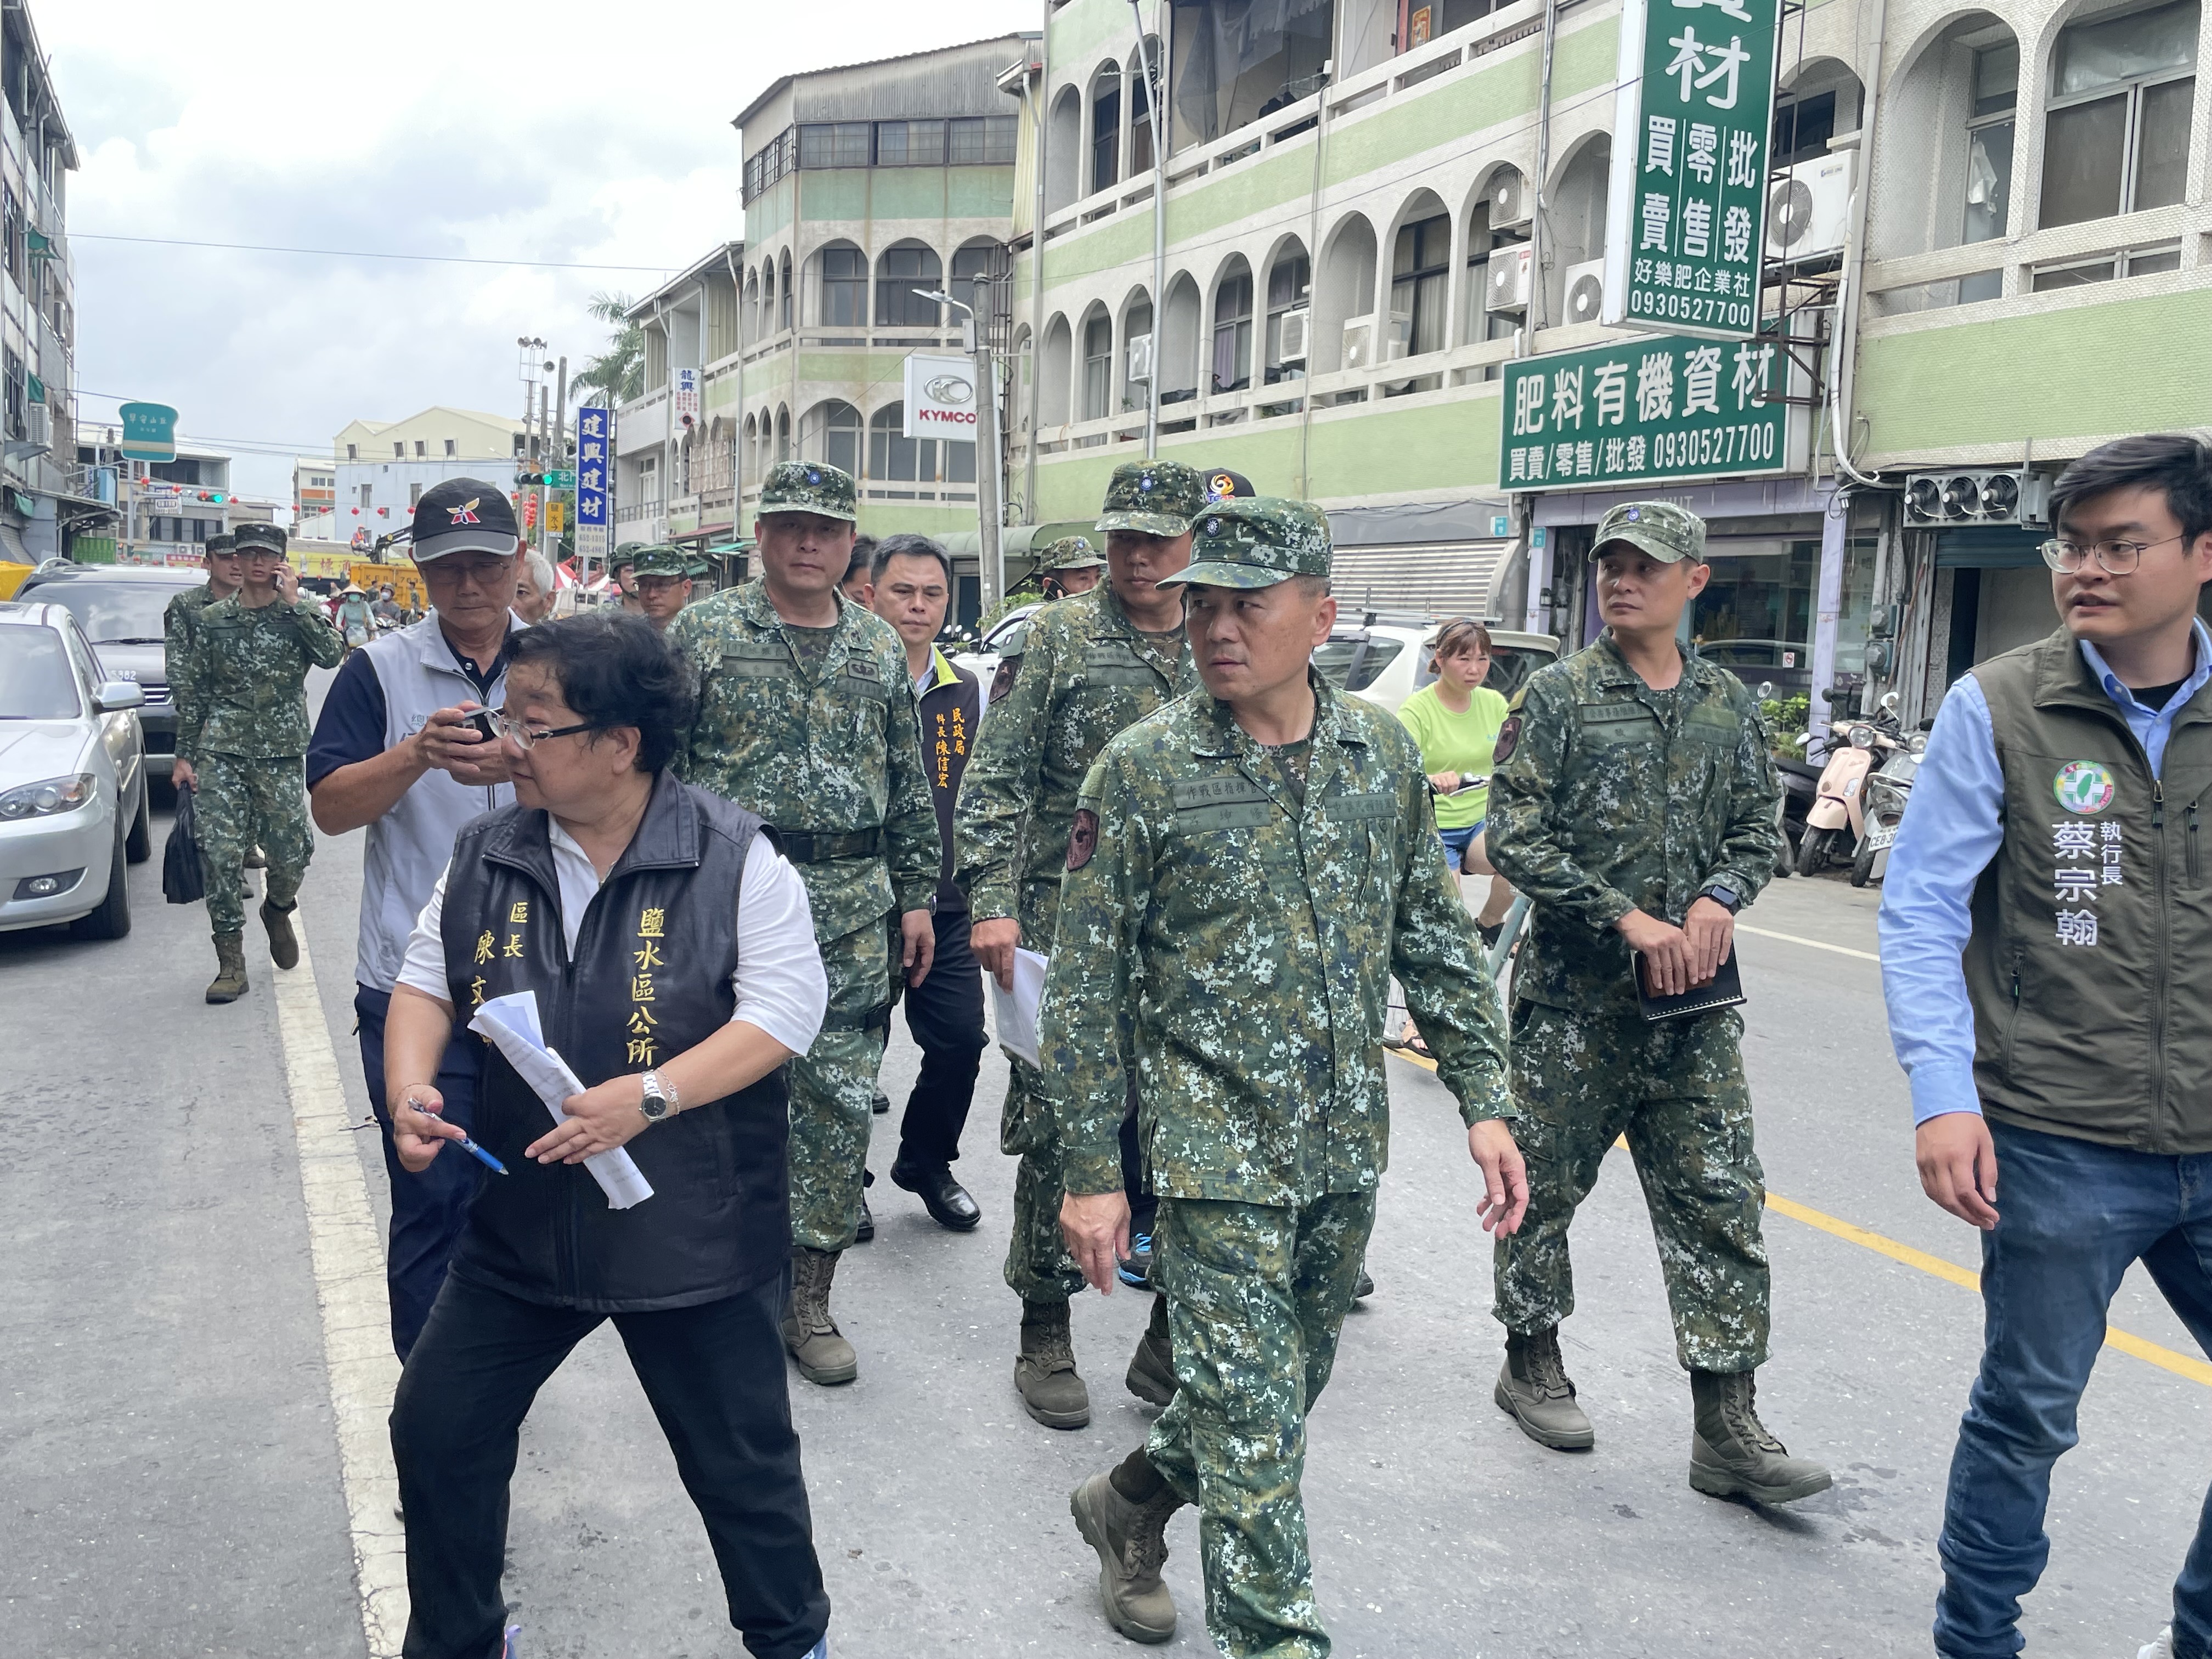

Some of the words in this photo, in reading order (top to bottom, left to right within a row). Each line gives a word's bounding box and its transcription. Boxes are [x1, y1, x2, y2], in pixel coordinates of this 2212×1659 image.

[1639, 115, 1677, 253] 買賣
[1682, 122, 1718, 258] 零售
[1723, 129, 1758, 264] 批發
[1630, 289, 1751, 327] 0930527700
[1634, 257, 1751, 299] 好樂肥企業社
[680, 369, 695, 392] 龍興
[1513, 342, 1775, 437] 肥料有機資材
[919, 409, 976, 424] KYMCO
[580, 414, 605, 518] 建興建材
[1509, 435, 1647, 482] 買賣/零售/批發
[1653, 421, 1775, 470] 0930527700
[952, 708, 966, 756] 民政局
[2051, 821, 2098, 946] 蔡宗翰
[2100, 821, 2123, 885] 執行長
[503, 901, 528, 958] 區長
[626, 907, 665, 1067] 鹽水區公所
